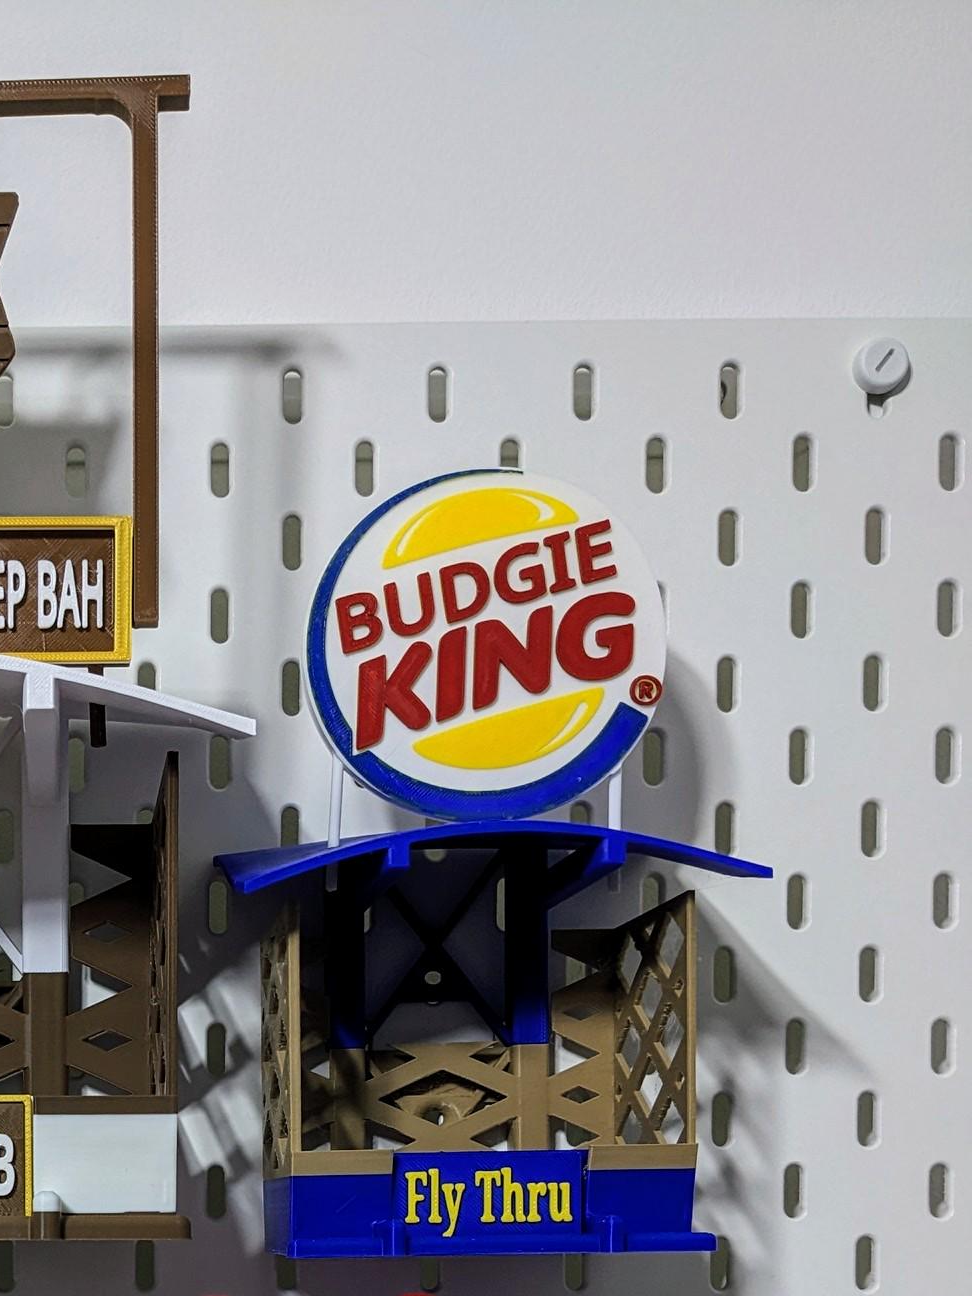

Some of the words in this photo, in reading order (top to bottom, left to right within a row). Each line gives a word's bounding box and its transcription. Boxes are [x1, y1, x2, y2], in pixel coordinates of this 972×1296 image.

[36, 558, 104, 630] BAH
[334, 518, 619, 657] BUDGIE
[355, 590, 637, 752] KING
[404, 1167, 466, 1238] Fly
[474, 1166, 574, 1224] Thru
